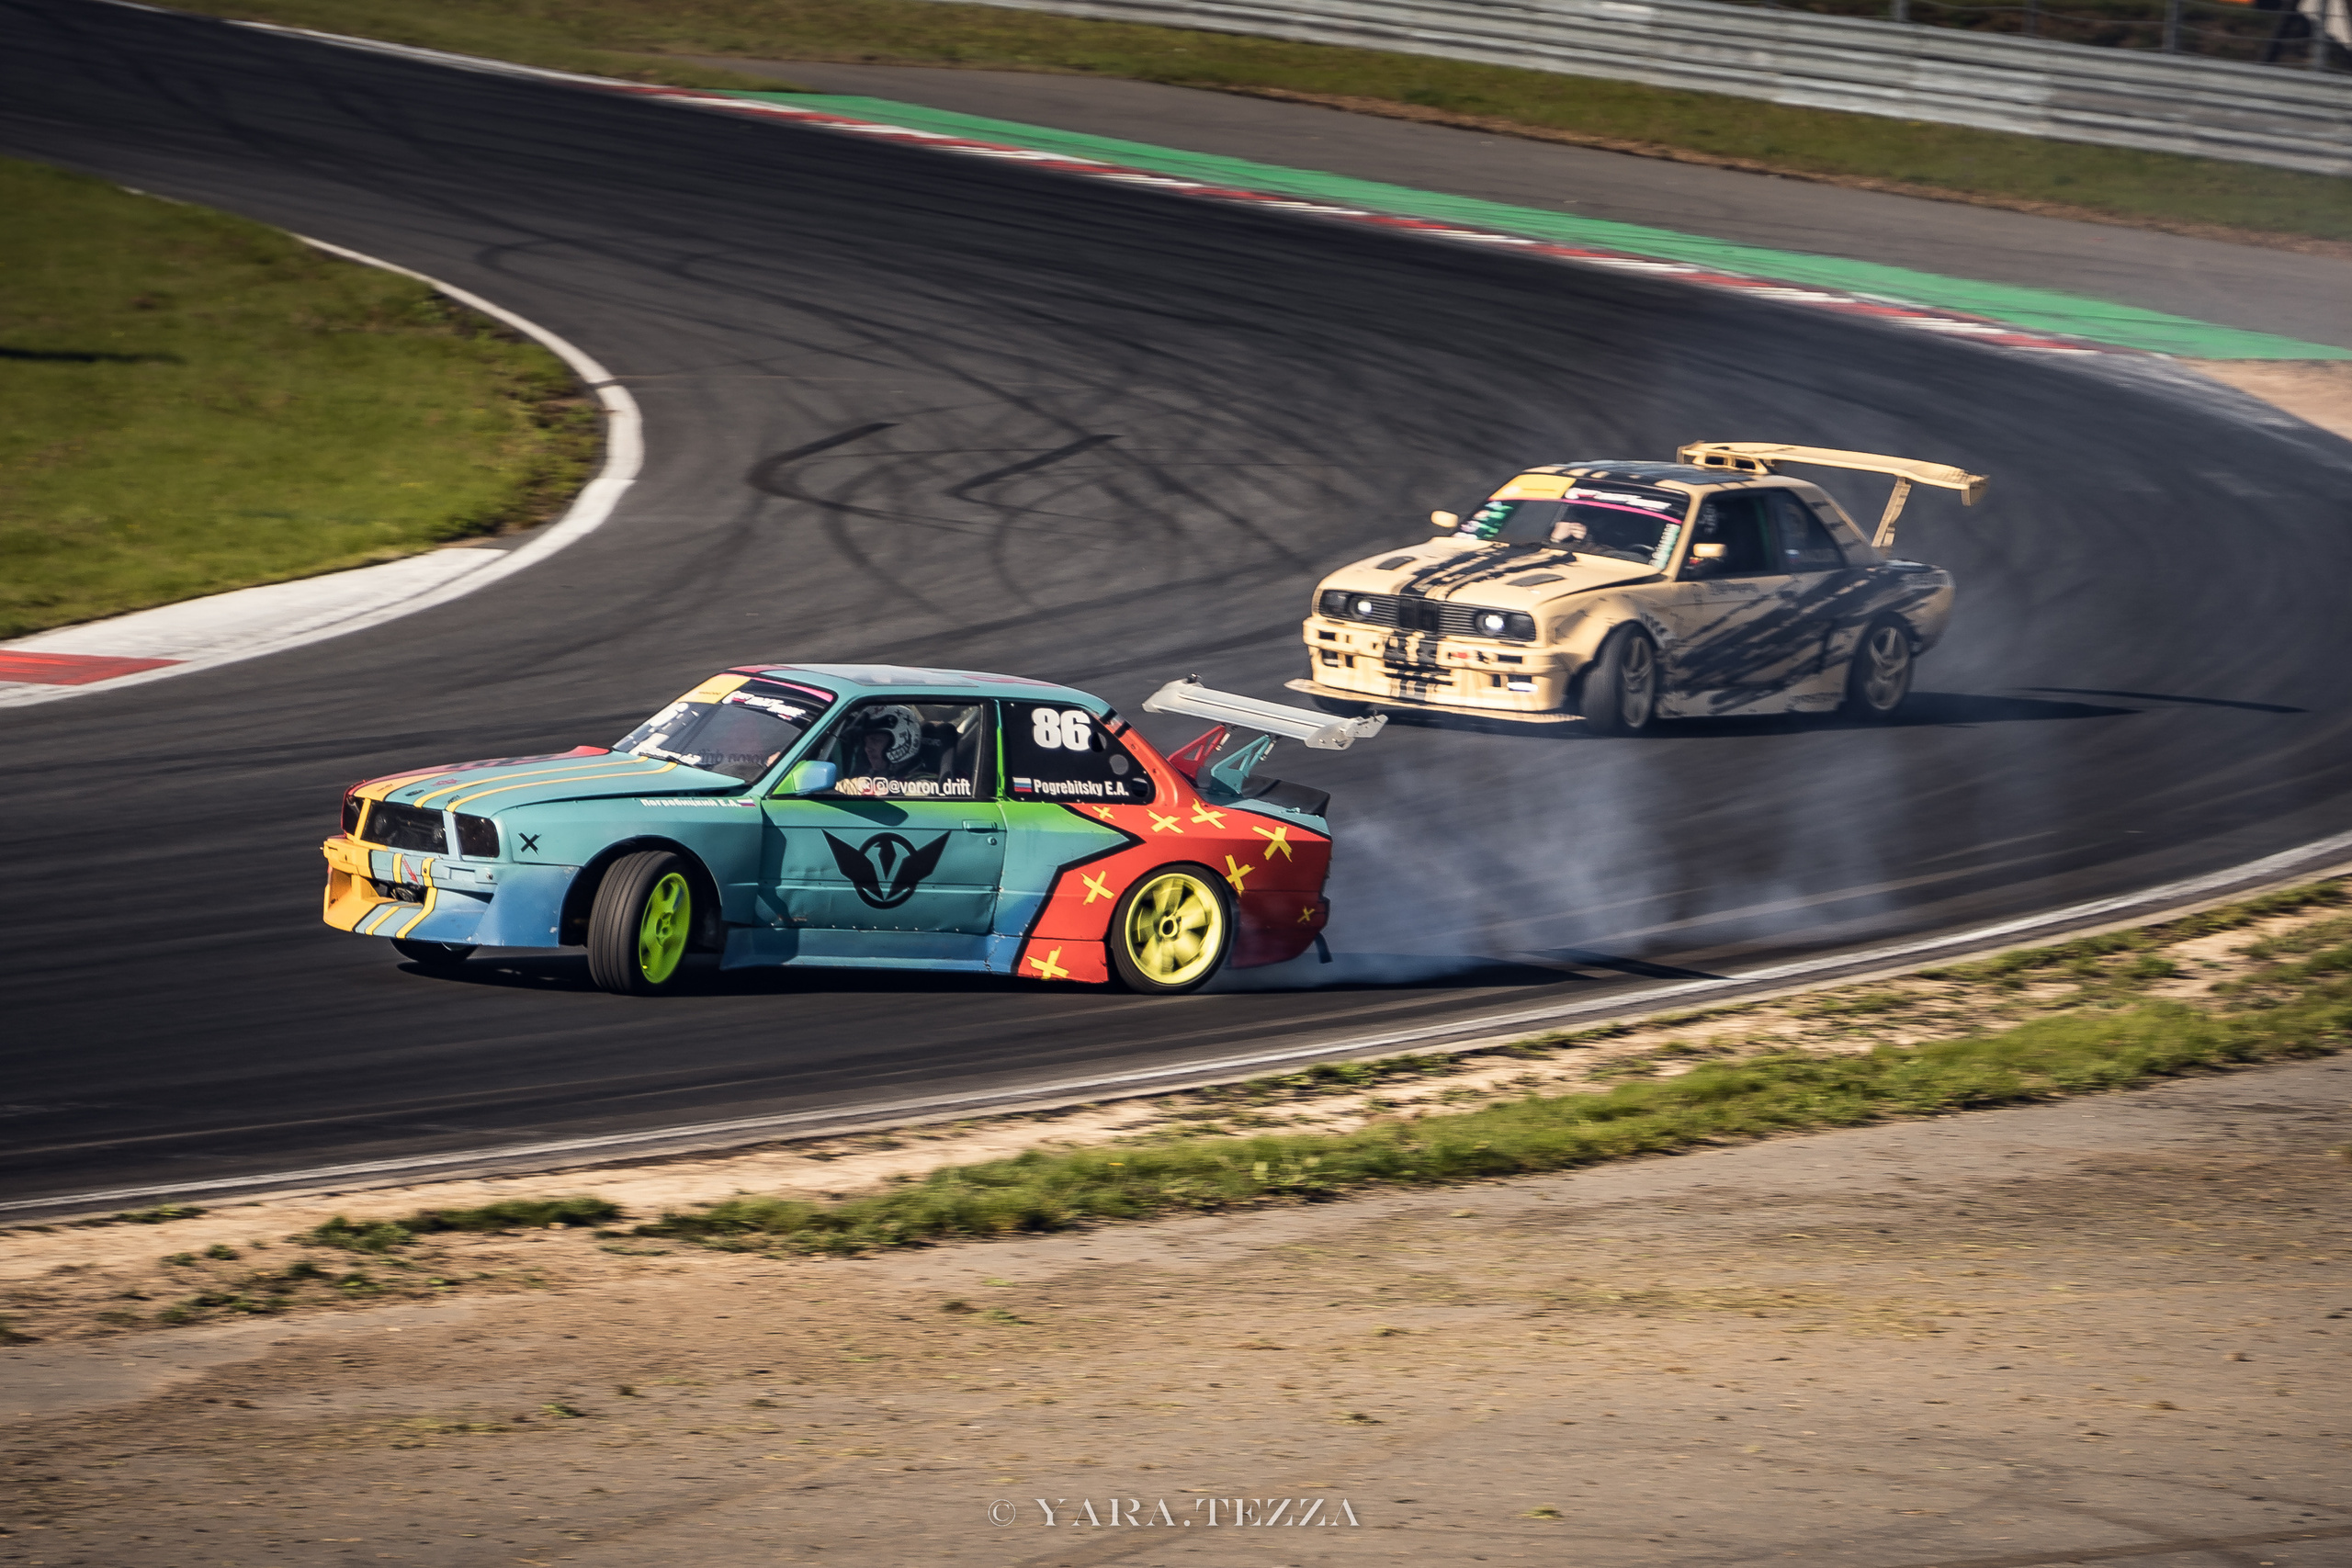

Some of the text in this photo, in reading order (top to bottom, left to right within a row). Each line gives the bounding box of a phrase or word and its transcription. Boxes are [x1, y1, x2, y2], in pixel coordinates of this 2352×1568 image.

[1031, 707, 1092, 751] 86
[888, 777, 971, 796] @voron_drift
[1033, 778, 1130, 796] Pogrebitsky E.A.
